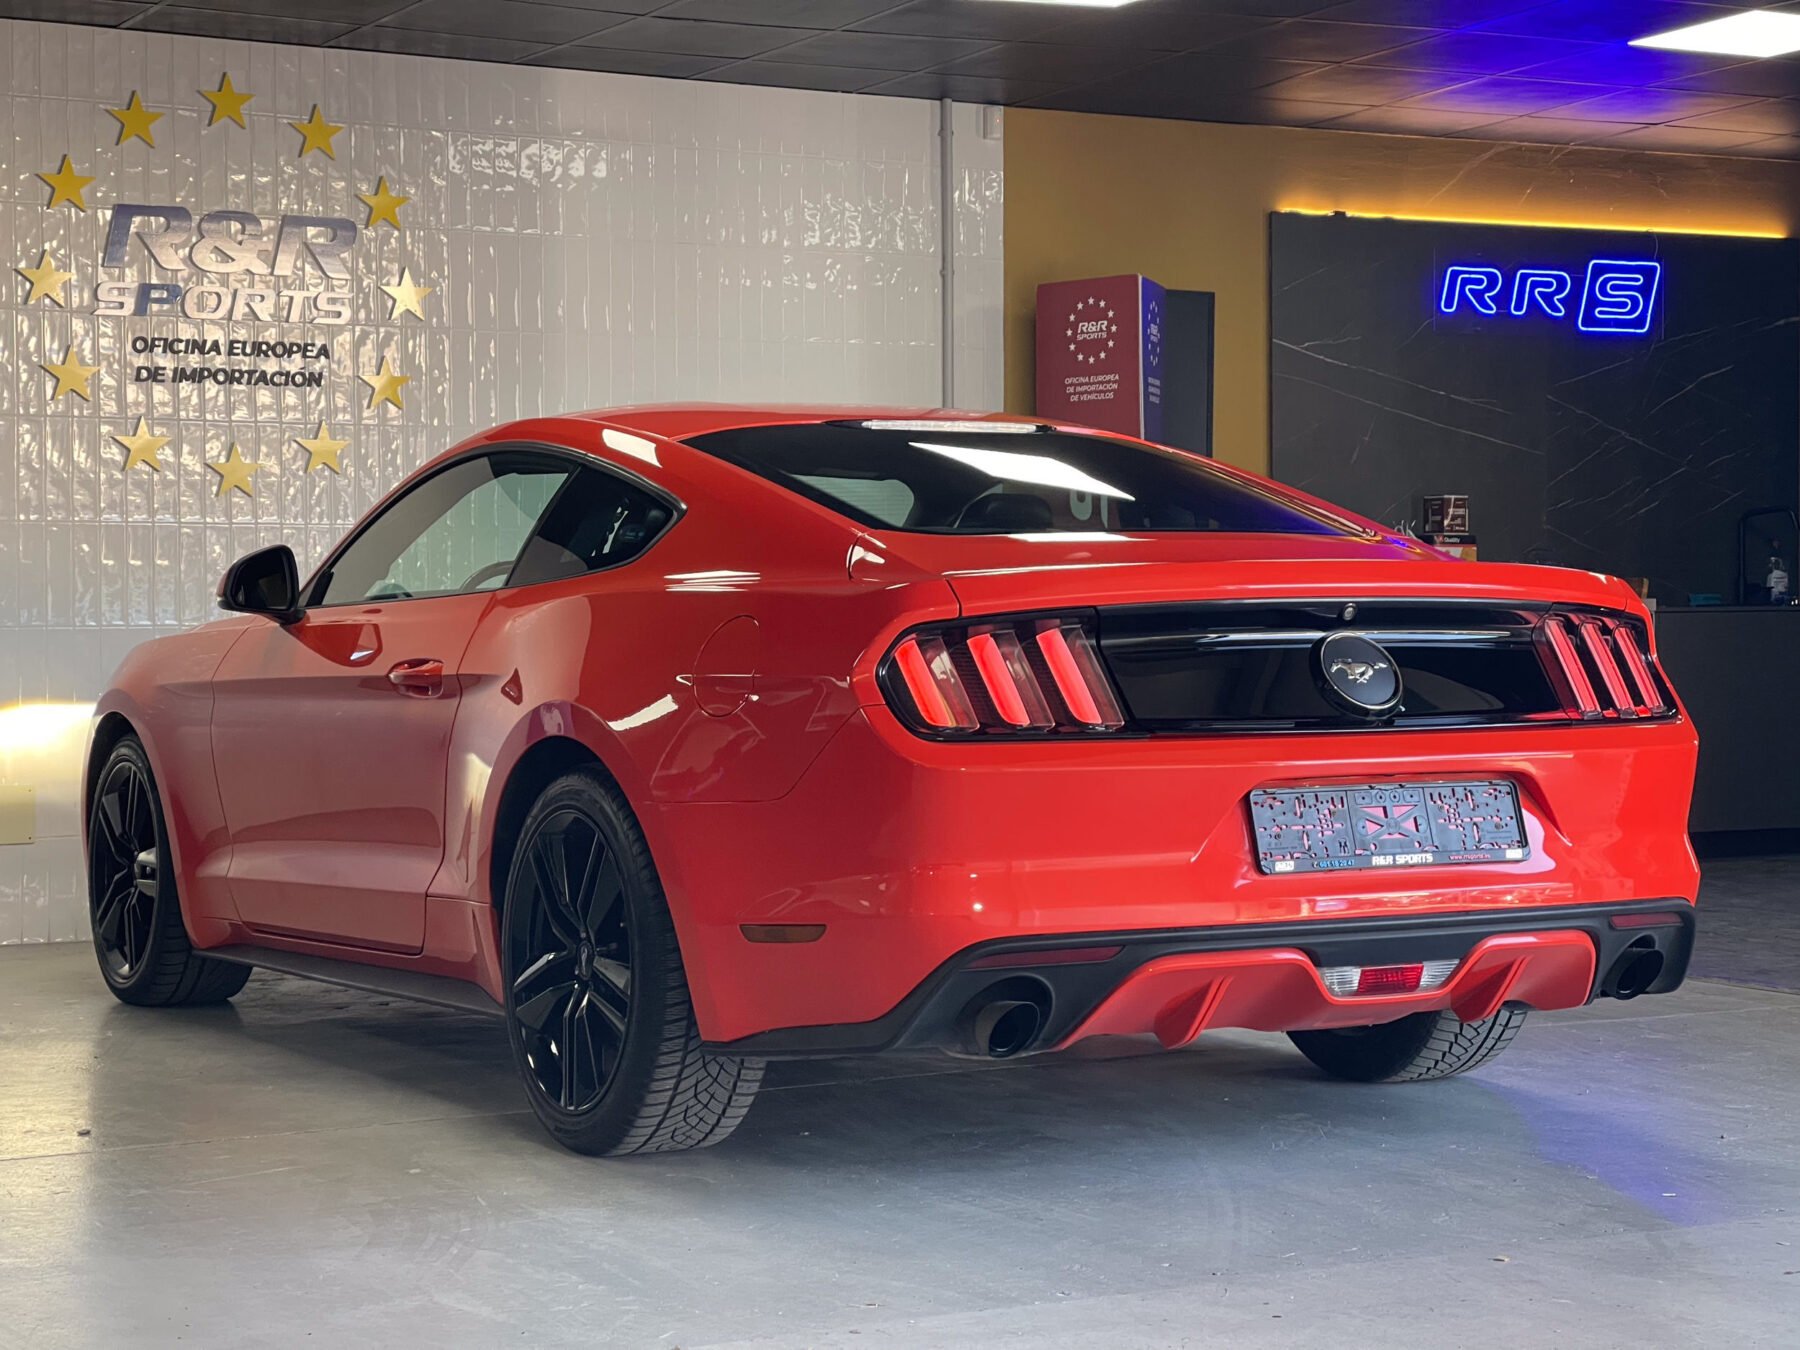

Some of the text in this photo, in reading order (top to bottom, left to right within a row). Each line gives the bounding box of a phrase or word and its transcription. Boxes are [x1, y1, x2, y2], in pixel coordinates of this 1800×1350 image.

[103, 204, 357, 279] R&R
[1441, 265, 1646, 320] RRS
[92, 282, 354, 325] SPORTS
[1077, 320, 1107, 333] R&R
[1077, 332, 1107, 340] SPORTS
[132, 336, 330, 360] OFICINA EUROPEA
[135, 366, 323, 387] DE IMPORTACIÓN
[1064, 373, 1120, 384] OFICINA EUROPEA
[1076, 383, 1118, 392] IMPORTACIÓN
[1070, 392, 1114, 402] DE VEHÍCULOS
[1372, 853, 1433, 866] R&R SPORTS
